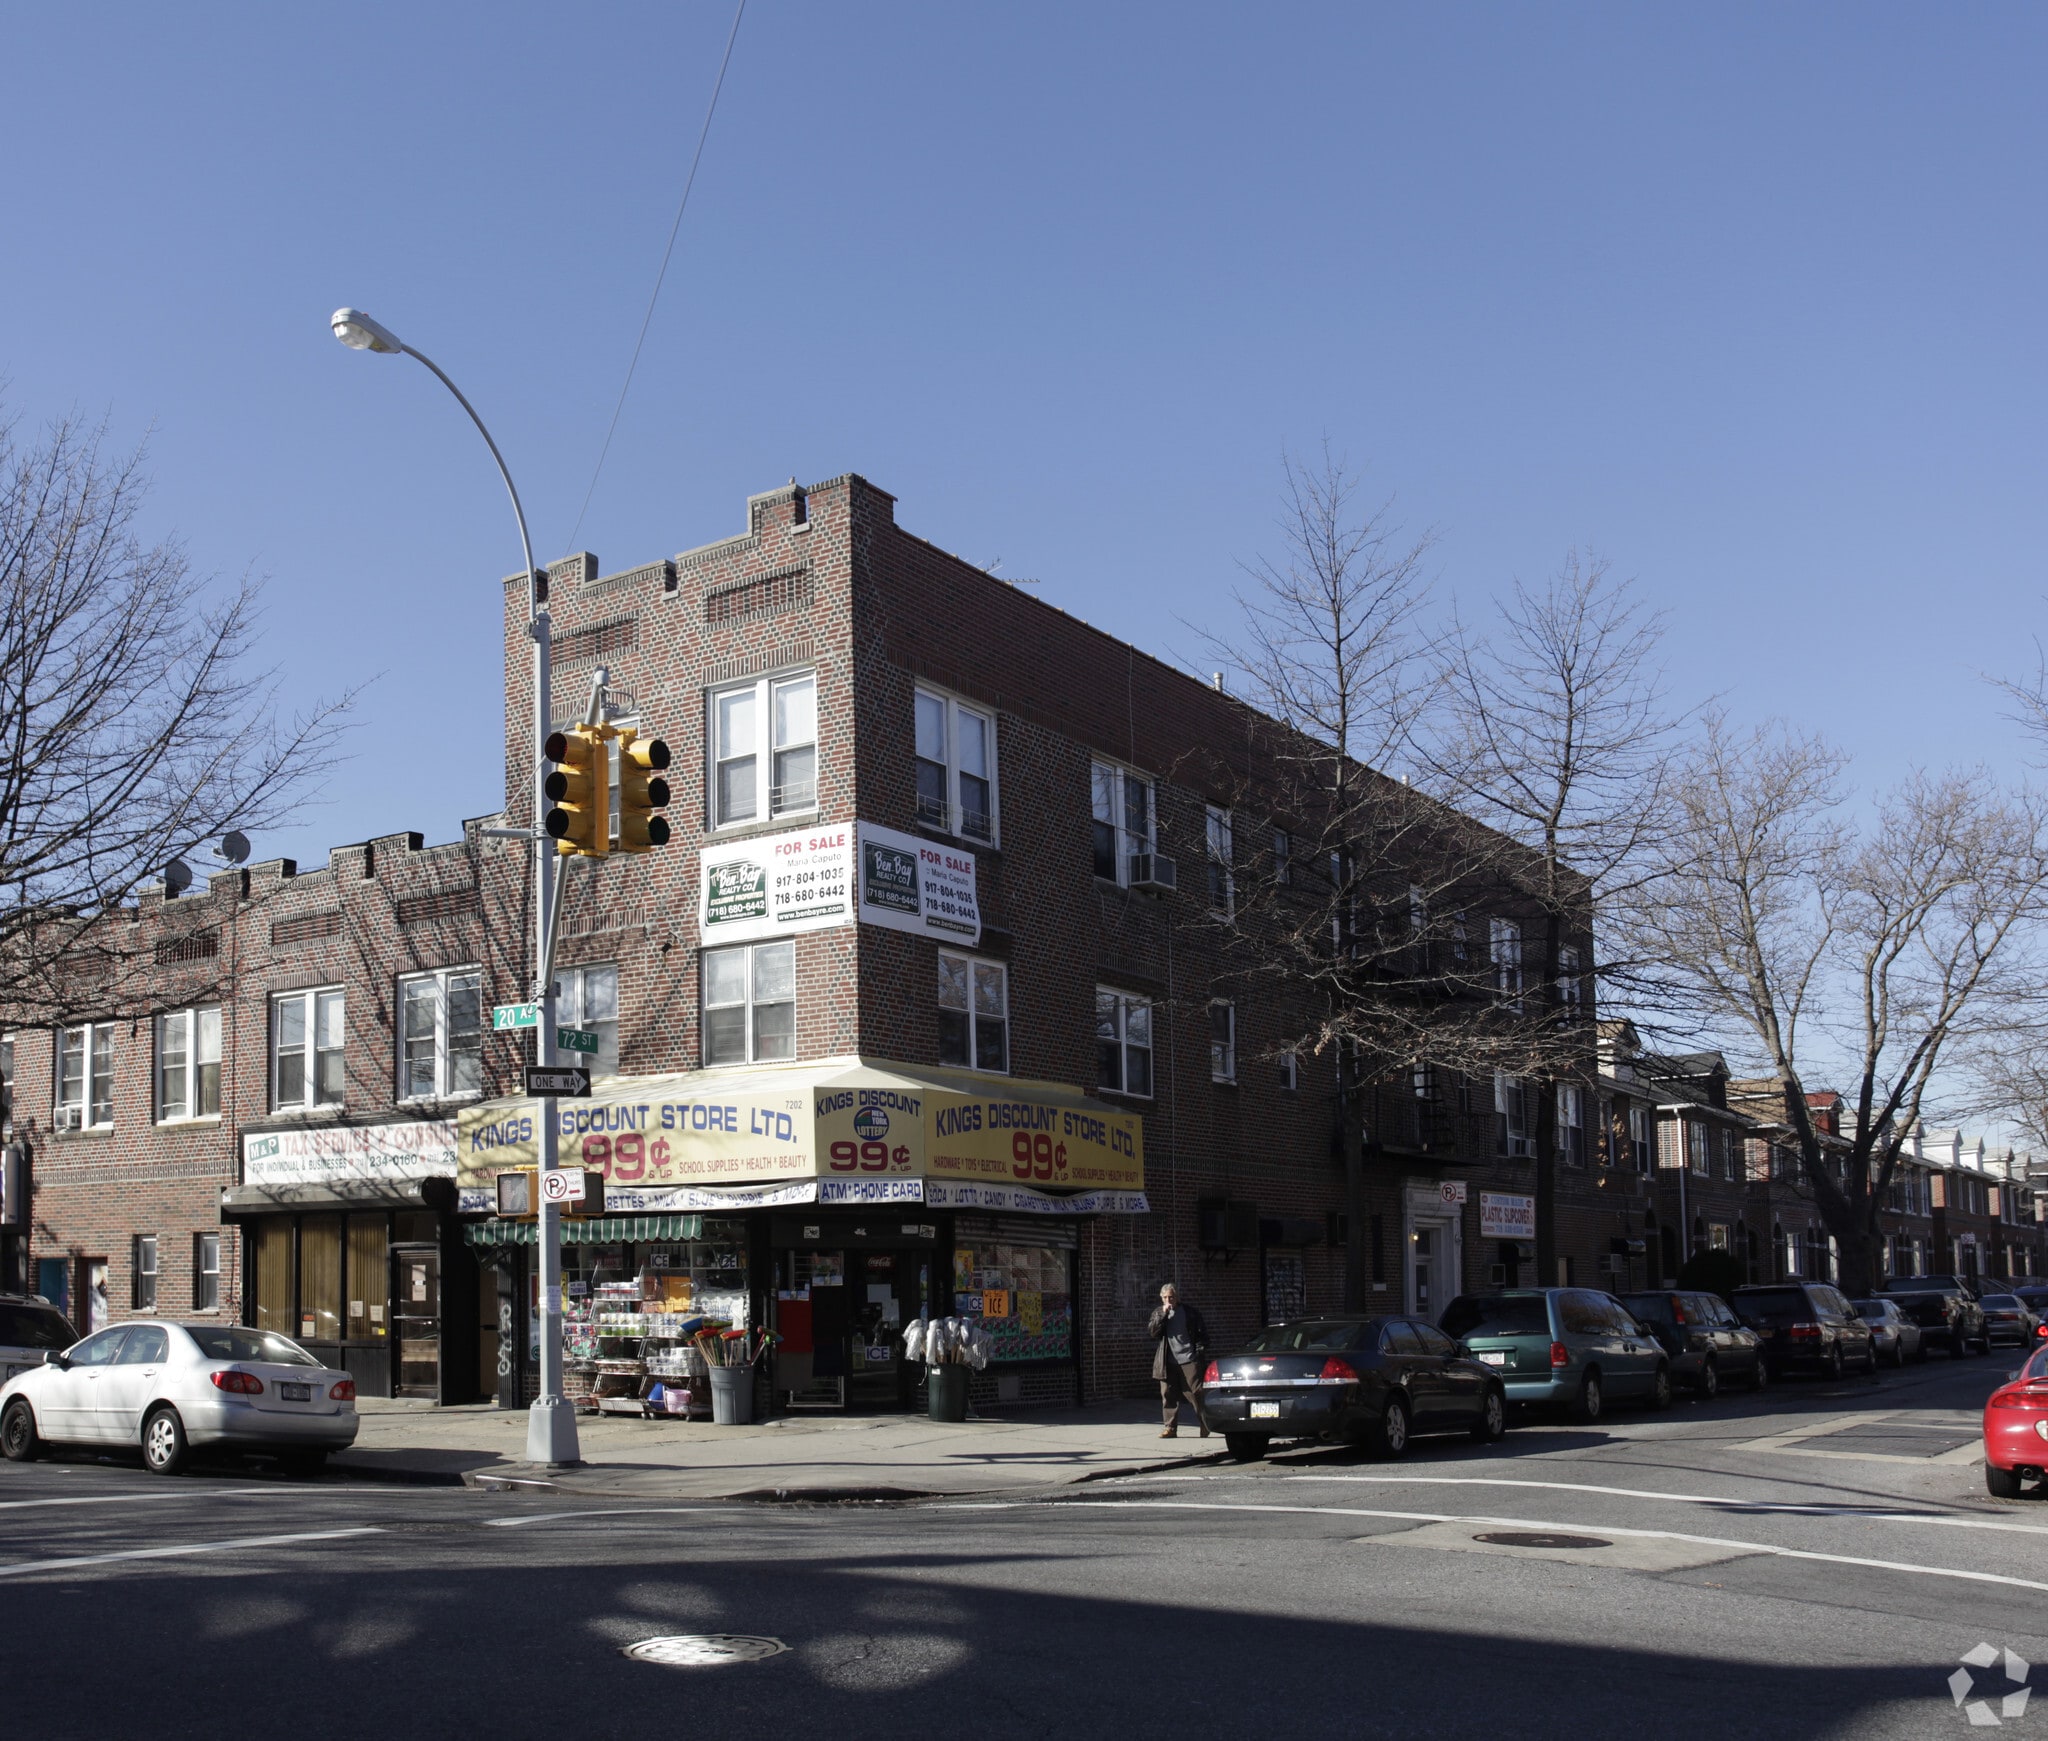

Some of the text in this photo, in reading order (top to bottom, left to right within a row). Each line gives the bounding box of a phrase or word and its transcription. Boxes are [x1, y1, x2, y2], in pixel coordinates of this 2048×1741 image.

[775, 834, 845, 857] FOR SALE
[787, 853, 842, 867] Maria Caputo
[920, 848, 941, 865] FOR
[945, 857, 971, 874] SALE
[776, 867, 844, 888] 917-804-1035
[931, 868, 947, 880] Maria
[948, 873, 969, 886] Caputo
[775, 884, 845, 905] 718-680-6442
[867, 887, 885, 900] (718)
[886, 891, 918, 907] 680-6442
[925, 881, 973, 904] 917-804-1035
[708, 905, 727, 918] (718)
[728, 900, 765, 913] 680-6442
[778, 905, 844, 920] www.benbayre.com
[926, 897, 976, 920] 718-680-6442
[499, 1008, 515, 1027] 20
[562, 1030, 593, 1049] 72 ST
[535, 1076, 582, 1088] ONE WAY
[785, 1100, 803, 1110] 7202
[816, 1090, 921, 1118] KINGS DISCOUNT
[871, 1109, 888, 1126] NEW YORK
[471, 1104, 797, 1154] KINGS ISCOUNT STORE LTD.
[857, 1125, 888, 1137] LOTTERY
[936, 1103, 1136, 1160] KINGS DISCOUNT STORE LTD.
[284, 1134, 308, 1156] TAX
[315, 1128, 370, 1155] SERVICE
[252, 1162, 264, 1173] FOR
[266, 1160, 299, 1173] INDIVIDUAL
[308, 1158, 347, 1171] BUSINESSES
[369, 1153, 417, 1167] 234-0160
[679, 1154, 807, 1175] SCHOOL SUPPLIES HEALTH BEAUTY
[934, 1155, 1008, 1174] HARDWARE TOYS ELECTRICAL
[660, 1170, 673, 1179] UP
[1060, 1173, 1069, 1181] UP
[821, 1183, 921, 1199] ATM PHONE CARD
[929, 1188, 947, 1203] SODA
[955, 1188, 978, 1204] LOTTO
[984, 1190, 1006, 1206] CANDY
[1125, 1197, 1145, 1210] MORE
[462, 1195, 487, 1209] SODA
[604, 1194, 645, 1210] RETTES
[654, 1194, 676, 1208] MILK
[1481, 1206, 1502, 1223] PLASTIC
[651, 1255, 668, 1267] ICE
[969, 1297, 982, 1310] ICE
[989, 1298, 1002, 1314] ICE
[866, 1347, 889, 1360] ICE
